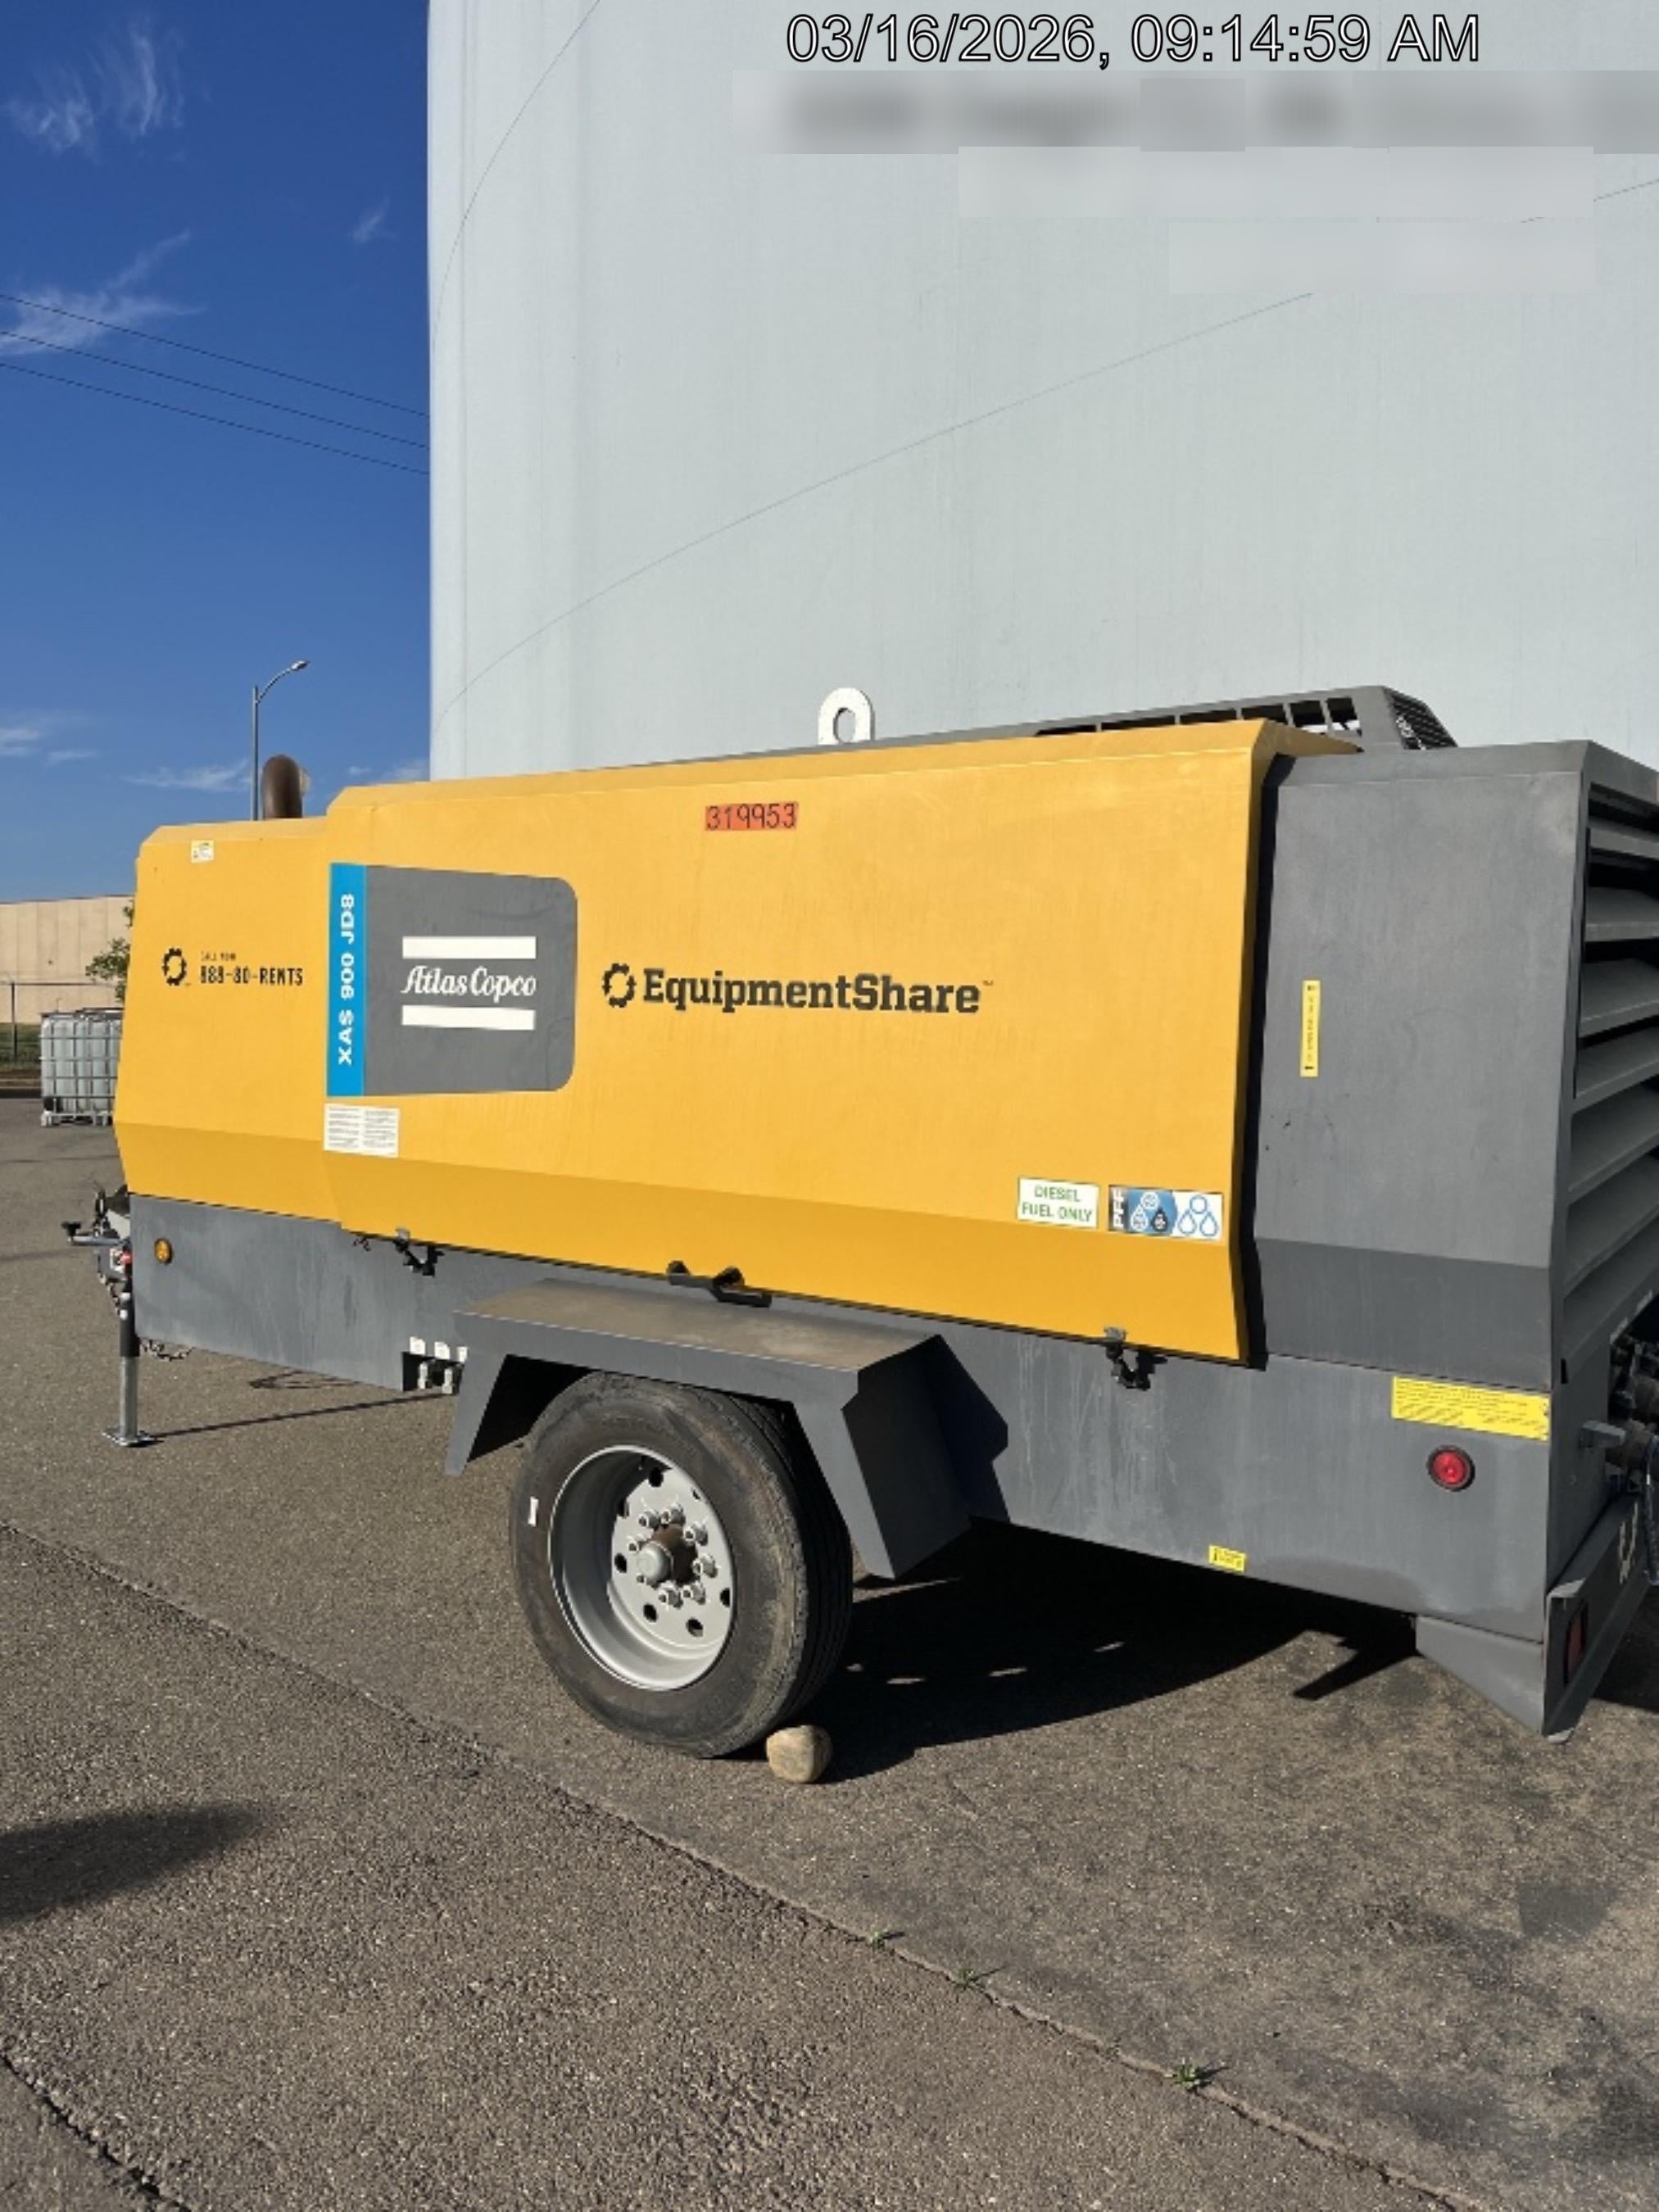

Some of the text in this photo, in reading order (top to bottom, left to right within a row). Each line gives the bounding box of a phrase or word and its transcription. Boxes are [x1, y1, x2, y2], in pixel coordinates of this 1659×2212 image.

[707, 803, 796, 830] 319953
[200, 965, 303, 986] 888-80-RENTS
[338, 894, 355, 1065] XAS 900 JD8
[400, 965, 537, 1004] Atlas Copco
[643, 968, 979, 1013] EquipmentShare
[1035, 1185, 1081, 1203] DIESEL
[1022, 1202, 1092, 1222] FUEL ONLY
